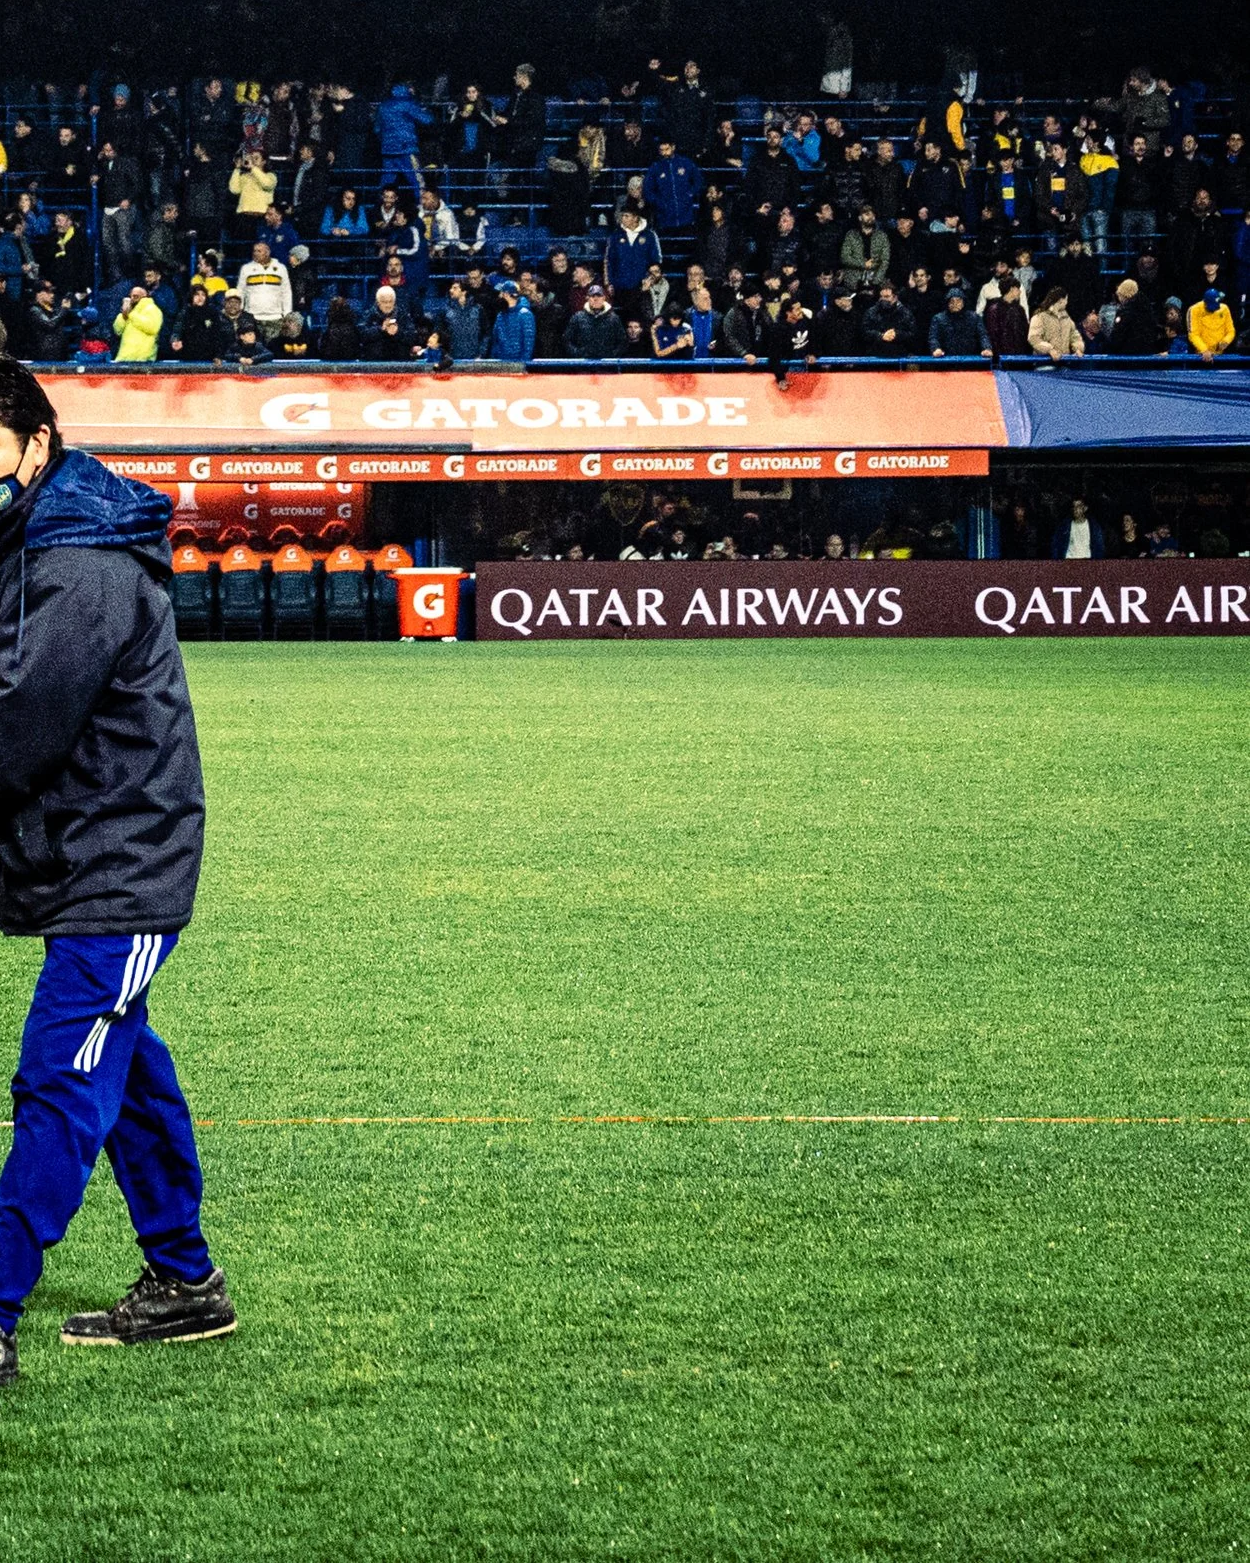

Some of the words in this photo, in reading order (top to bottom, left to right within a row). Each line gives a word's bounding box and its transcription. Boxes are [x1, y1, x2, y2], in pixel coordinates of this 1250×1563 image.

[361, 397, 748, 429] GATORADE
[103, 462, 176, 474] ATORADE
[222, 462, 303, 474] GATORADE
[349, 461, 430, 473] GATORADE
[476, 459, 557, 472] GATORADE
[612, 458, 694, 470] GATORADE
[740, 457, 821, 470] GATORADE
[867, 456, 949, 468] GATORADE
[269, 507, 327, 517] GATORADE
[412, 583, 445, 620] G
[490, 587, 665, 636] QATAR
[681, 587, 904, 627] AIRWAYS
[974, 585, 1150, 633] QATAR
